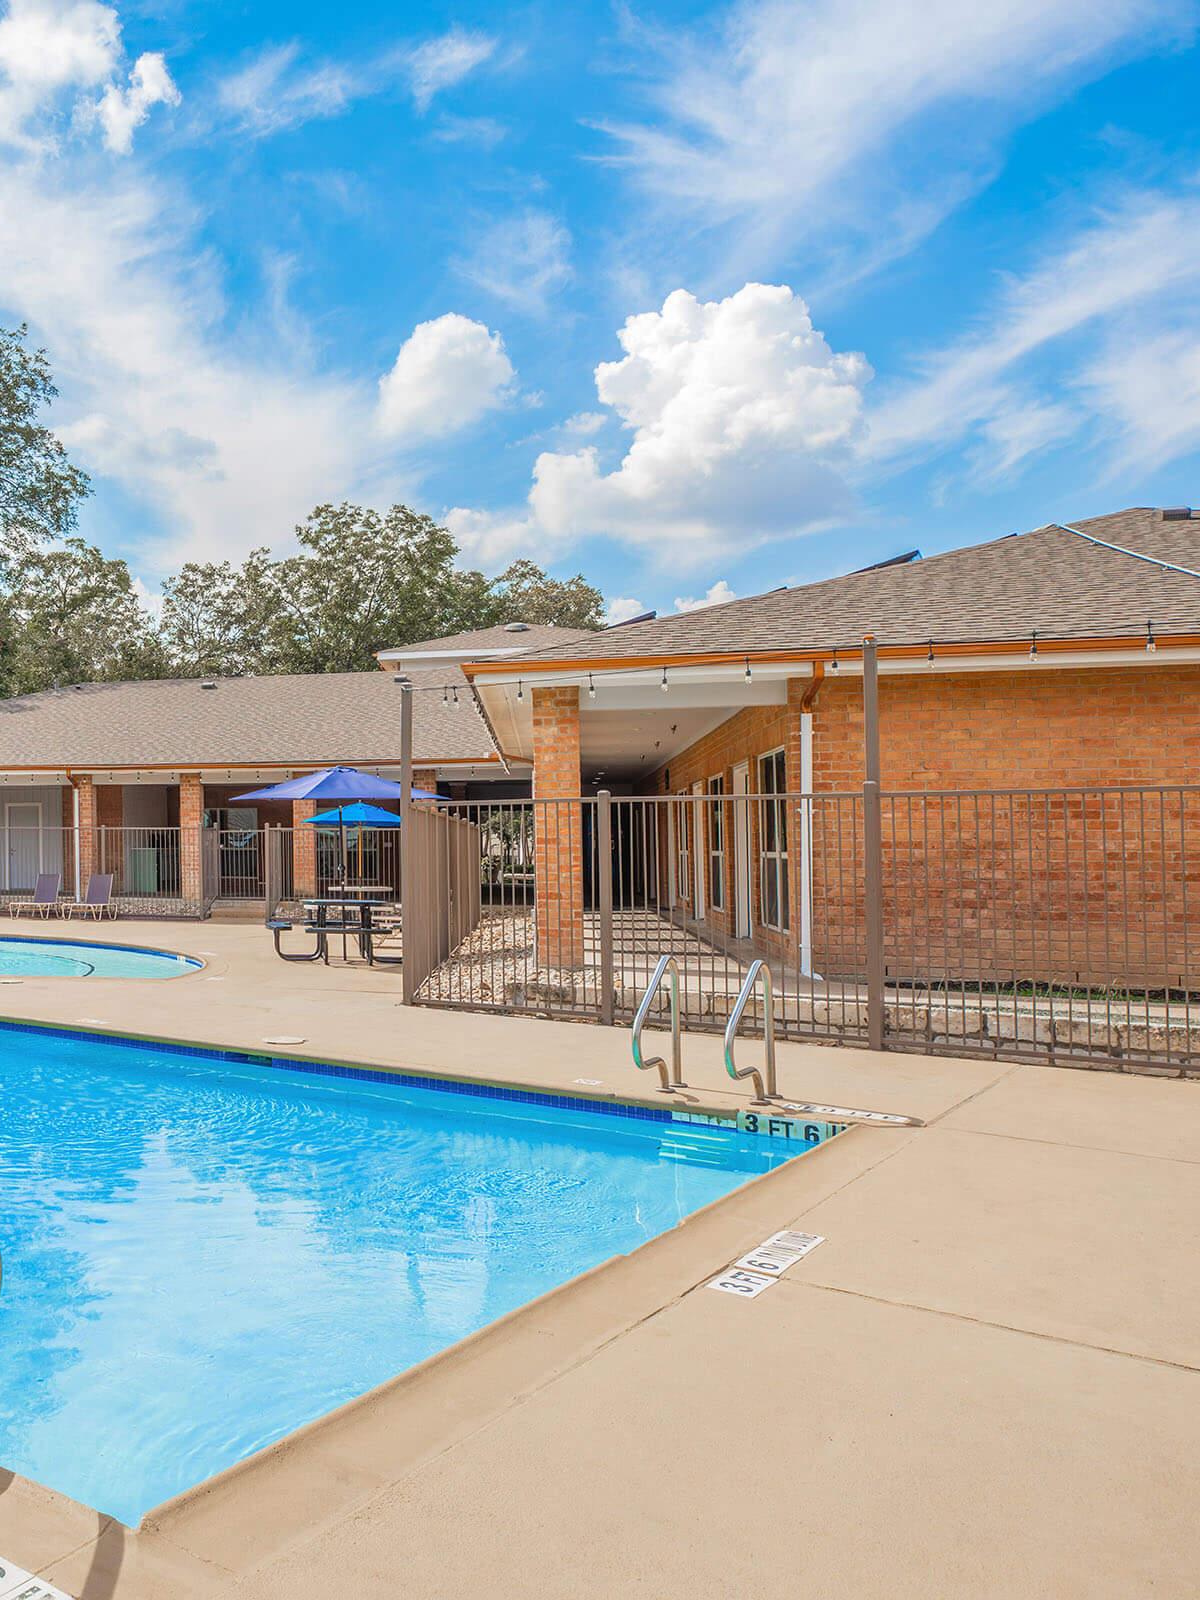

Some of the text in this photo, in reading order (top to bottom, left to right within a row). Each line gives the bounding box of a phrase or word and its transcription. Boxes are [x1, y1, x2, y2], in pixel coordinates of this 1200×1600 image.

[745, 1114, 759, 1133] 3
[768, 1119, 794, 1138] FT
[804, 1125, 820, 1144] 6
[746, 1260, 779, 1270] 6
[730, 1271, 769, 1285] FT
[719, 1281, 754, 1293] 3
